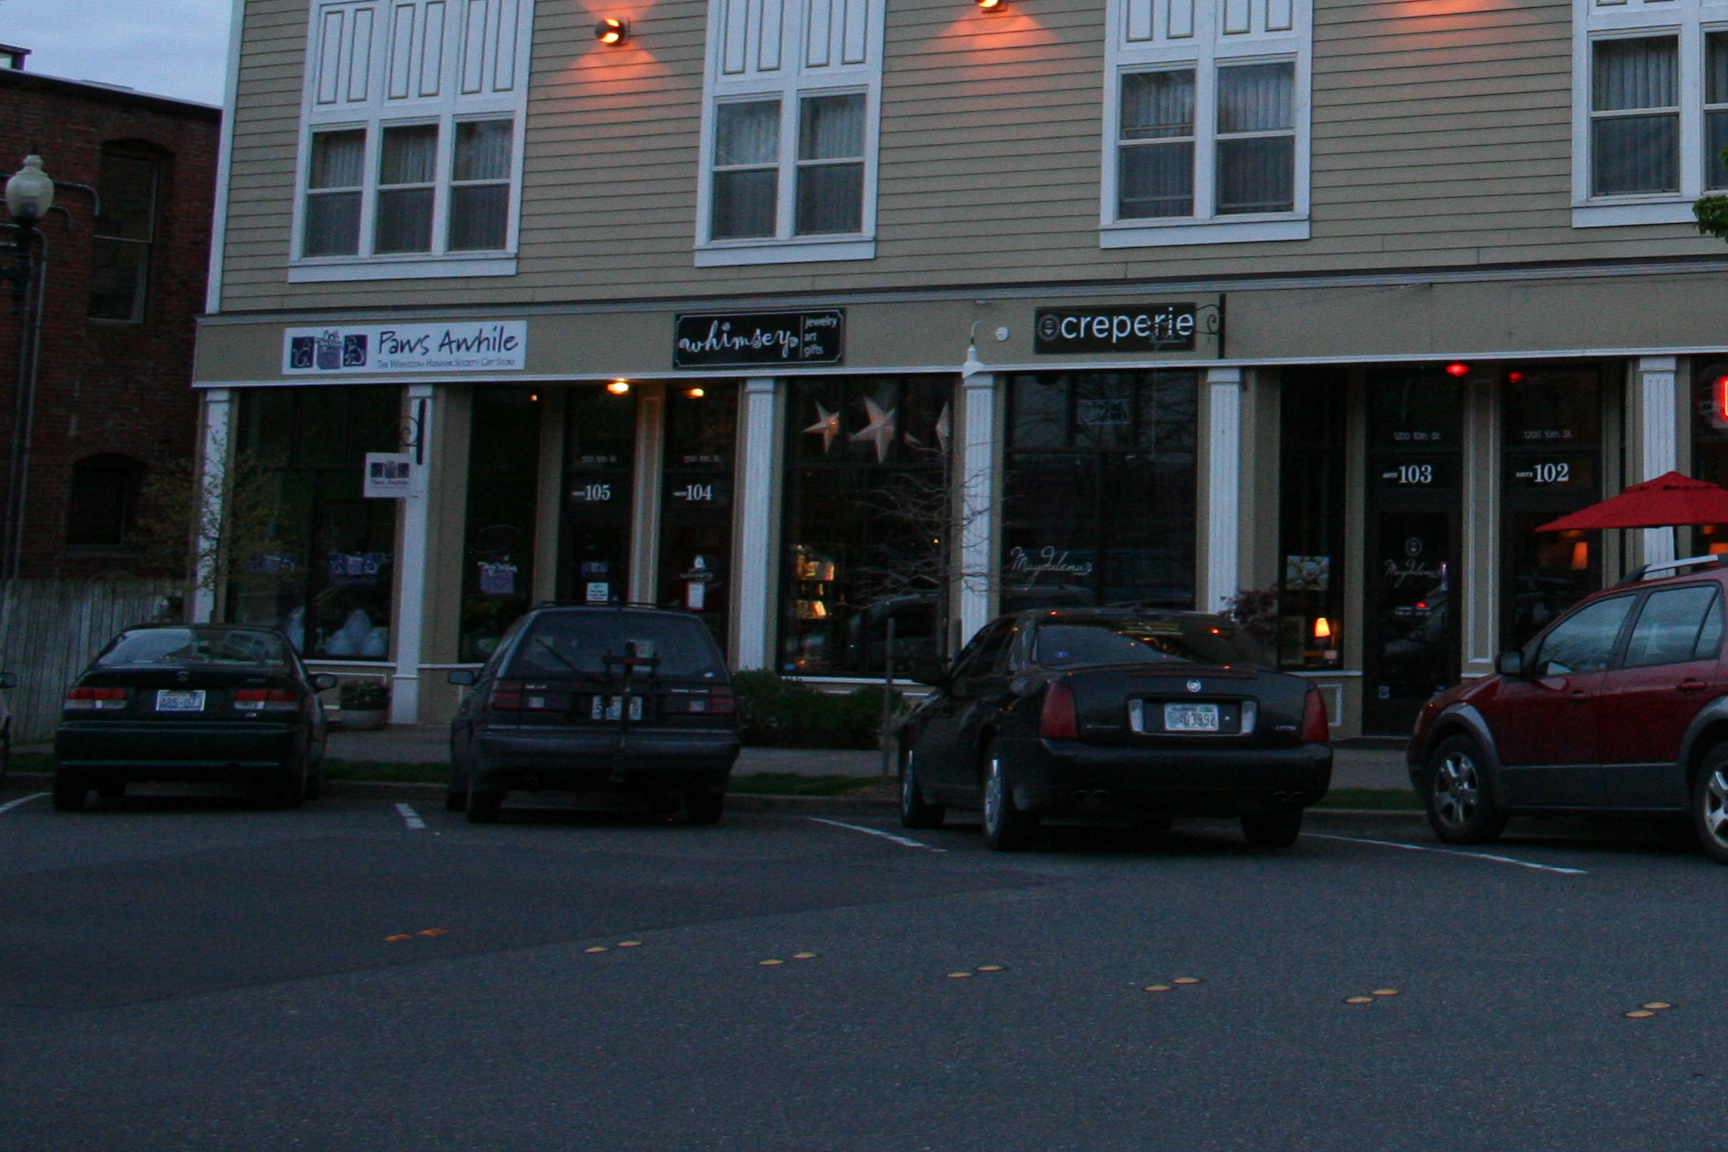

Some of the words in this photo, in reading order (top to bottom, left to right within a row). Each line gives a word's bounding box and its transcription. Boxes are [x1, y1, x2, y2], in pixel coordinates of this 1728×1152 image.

[1061, 306, 1195, 344] creperie
[377, 330, 431, 356] Paws
[438, 325, 520, 355] Awhile
[679, 319, 799, 359] whimsey
[1398, 464, 1432, 484] 103
[1533, 462, 1570, 483] 102
[585, 484, 611, 501] 105
[686, 484, 713, 501] 104
